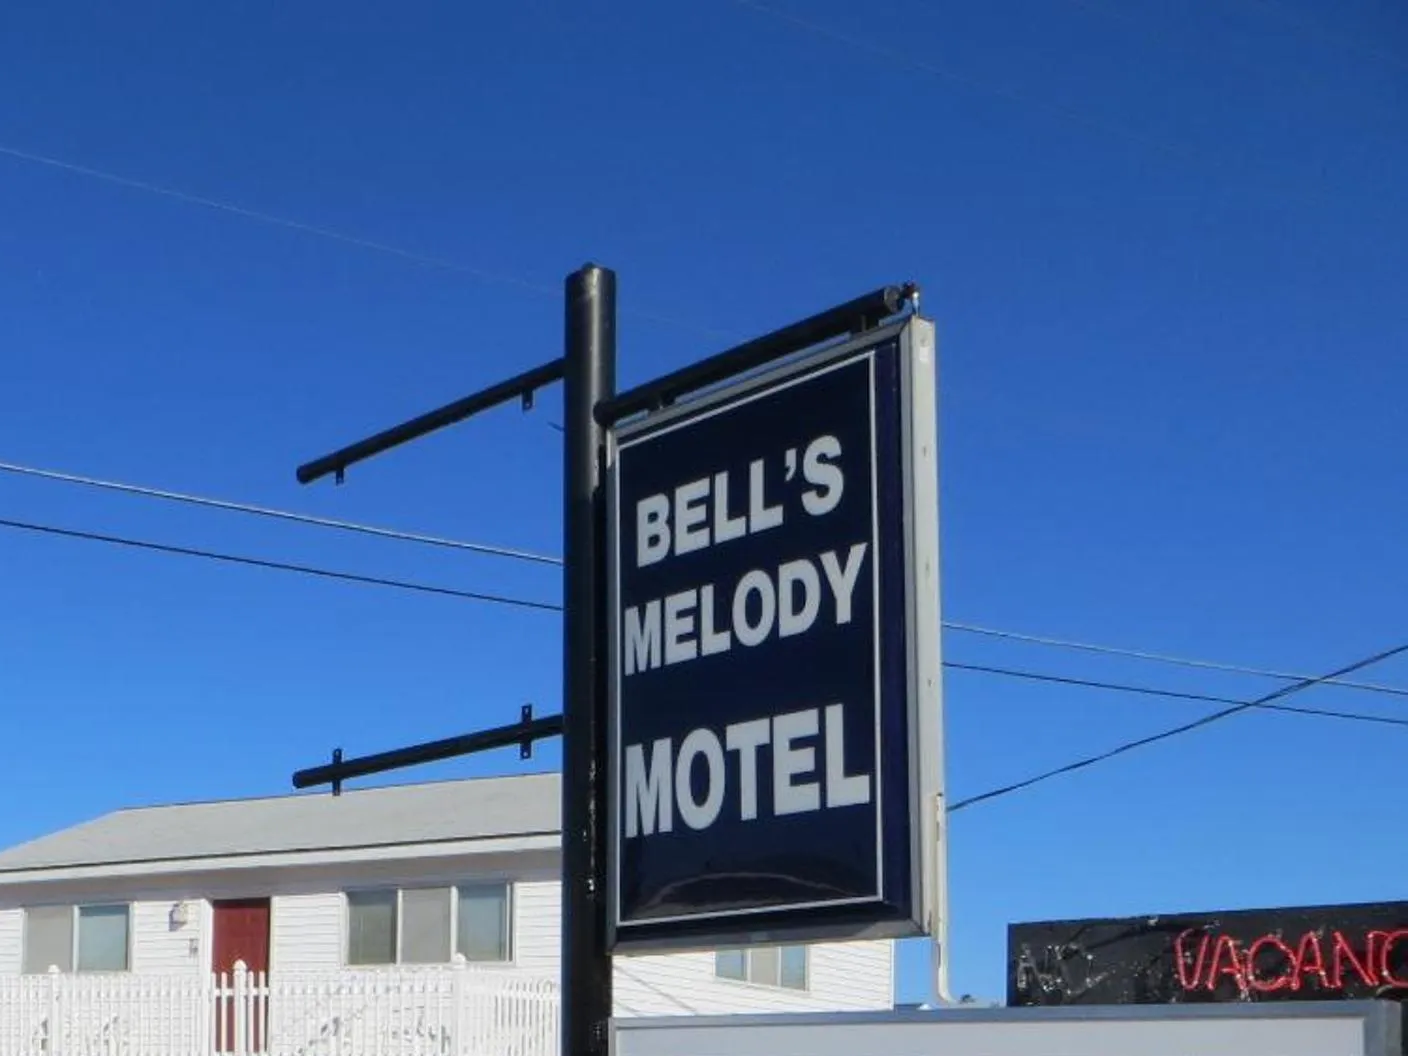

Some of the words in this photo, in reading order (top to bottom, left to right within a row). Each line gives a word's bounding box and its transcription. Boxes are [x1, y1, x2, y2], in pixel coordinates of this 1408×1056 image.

[636, 435, 843, 569] BELL'S
[624, 542, 868, 677] MELODY
[625, 703, 871, 839] MOTEL
